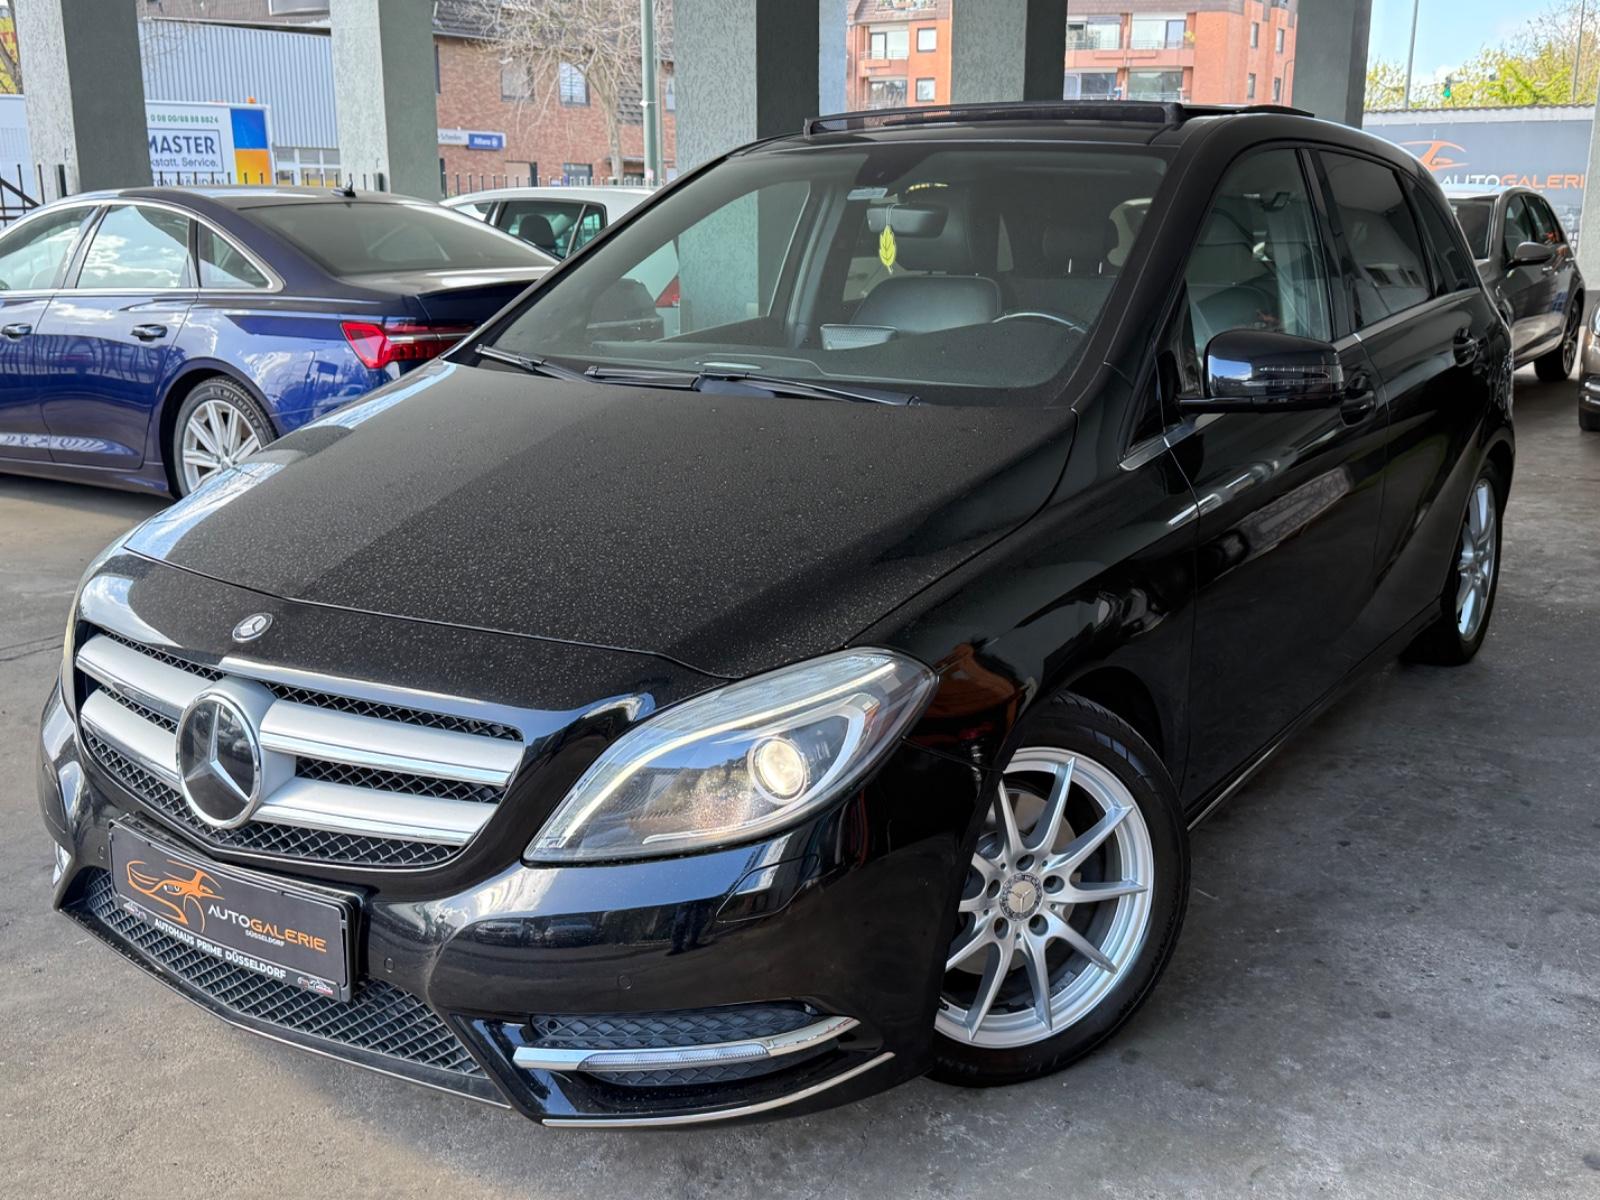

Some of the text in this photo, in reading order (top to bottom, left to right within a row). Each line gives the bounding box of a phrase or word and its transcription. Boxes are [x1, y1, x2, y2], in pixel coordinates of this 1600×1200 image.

[149, 135, 216, 154] MASTER
[154, 918, 286, 979] AUTOHAUS PRIME DÜSSELDORF
[208, 904, 327, 953] AUTOGALERIE
